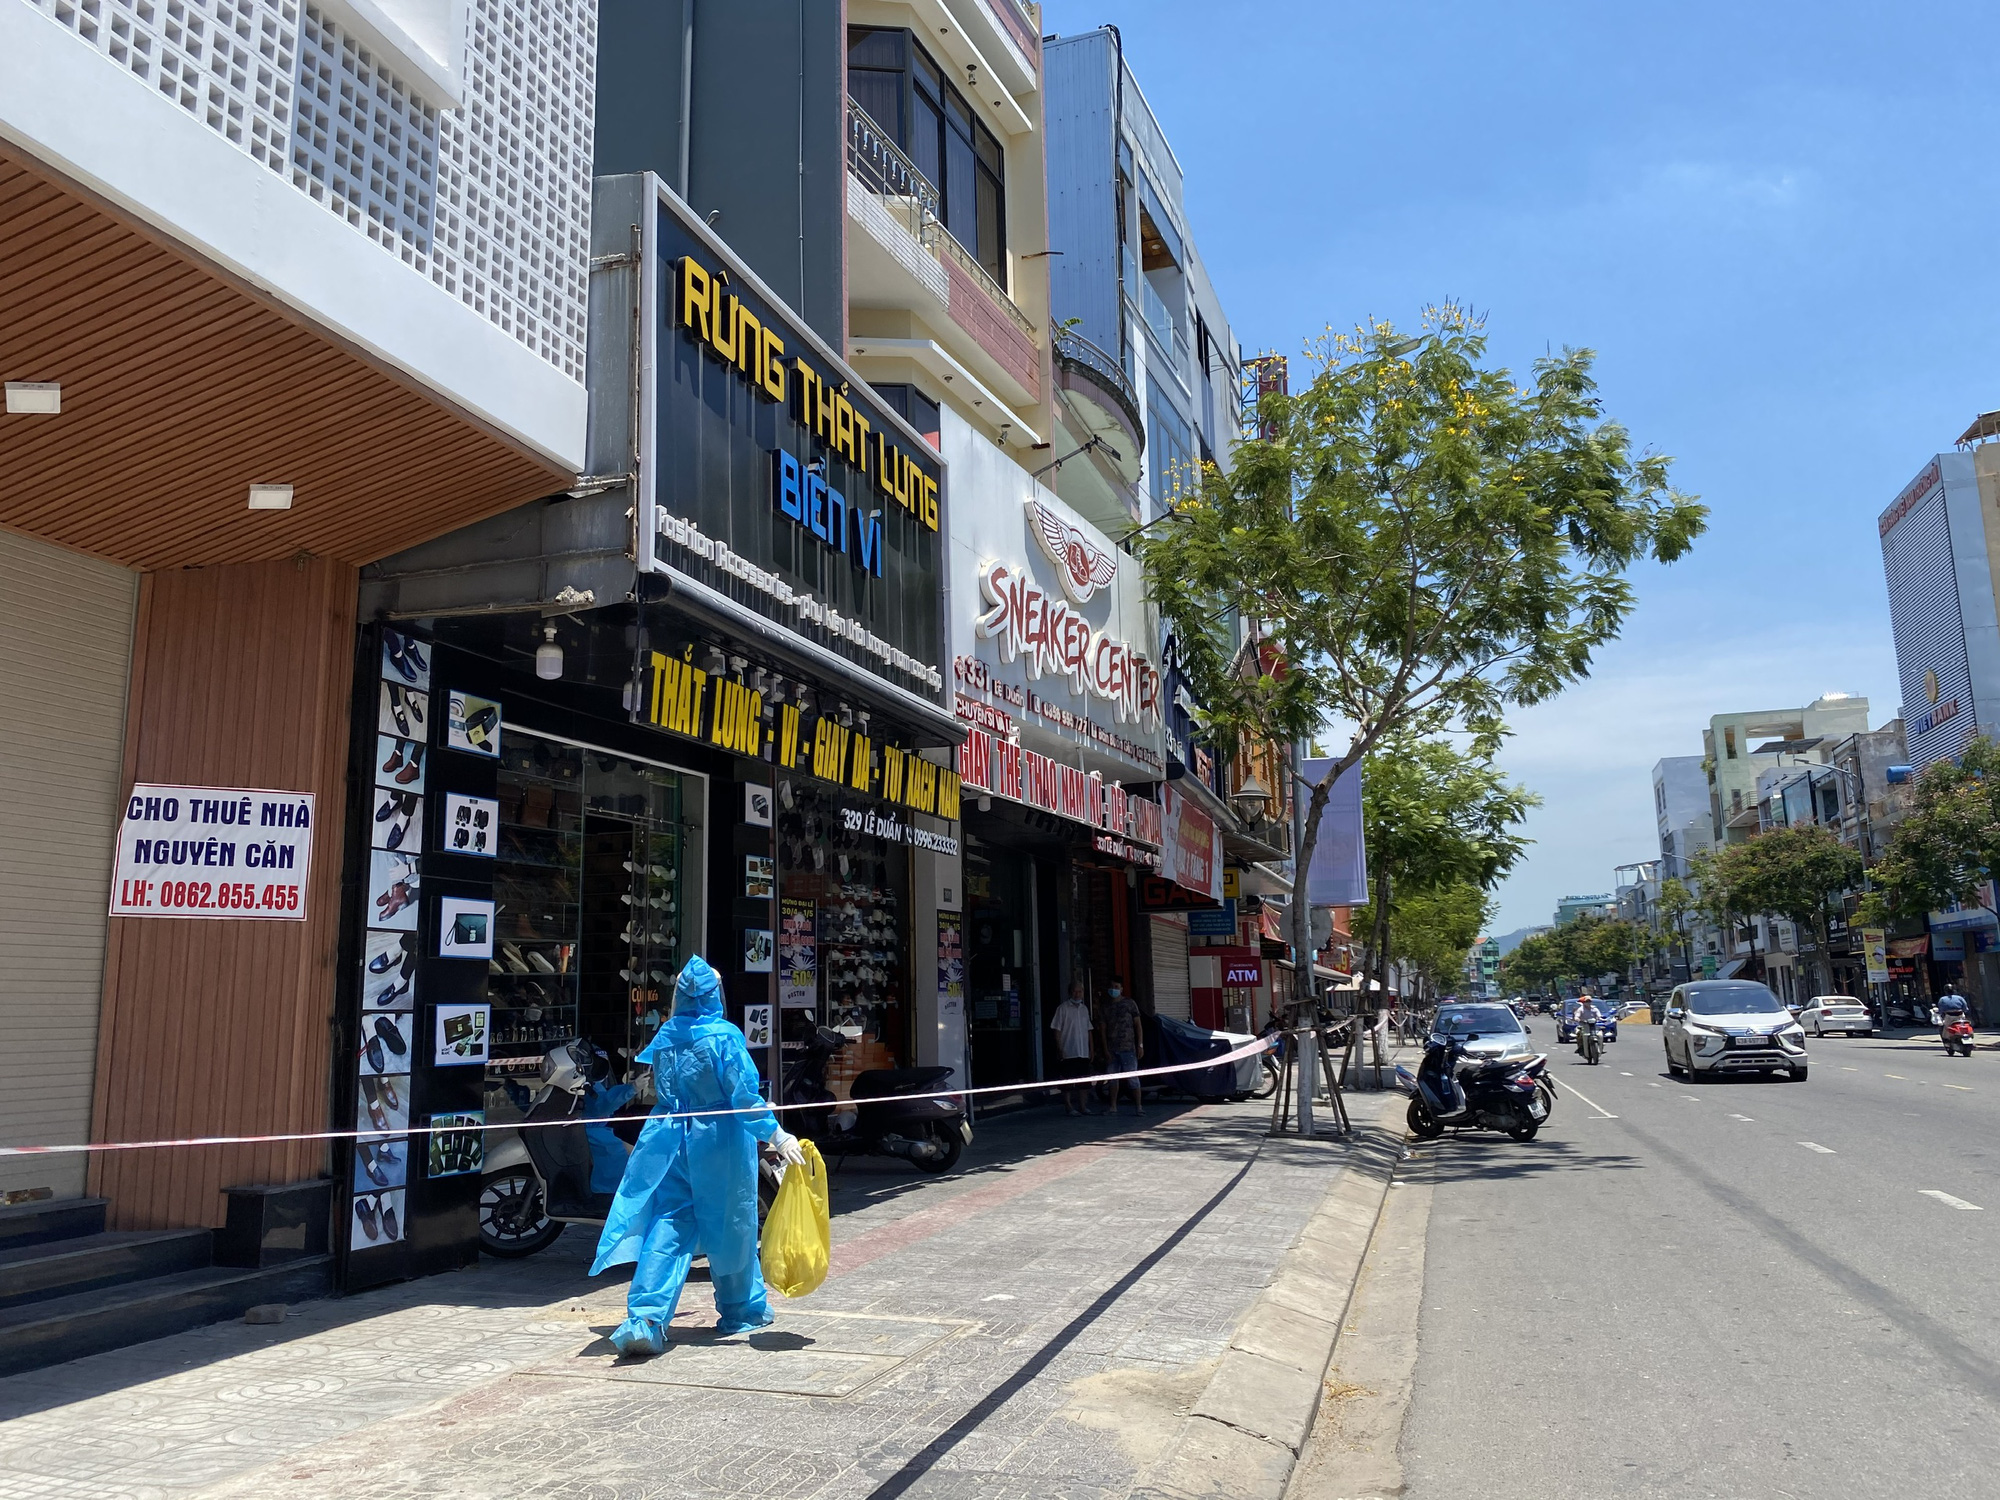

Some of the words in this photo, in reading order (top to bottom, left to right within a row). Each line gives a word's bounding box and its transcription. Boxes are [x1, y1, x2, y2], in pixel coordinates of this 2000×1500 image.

[656, 505, 714, 560] Fashion
[715, 540, 793, 605] Accessories
[986, 566, 1091, 687] SNEAKER
[1096, 638, 1161, 726] CENTER
[649, 644, 706, 737] THẮT
[711, 675, 762, 756] LƯNG
[851, 732, 871, 792] DA
[938, 766, 961, 821] NAM
[1915, 698, 1959, 735] VIETBANK
[1026, 750, 1057, 811] THAO
[1061, 765, 1086, 821] NAM
[127, 796, 179, 822] CHO
[189, 797, 252, 825] THUÊ
[260, 799, 310, 828] NHÀ
[844, 809, 862, 831] 329
[864, 809, 875, 834] LÊ
[134, 837, 236, 867] NGUYÊN
[245, 839, 296, 869] CĂN
[121, 879, 154, 907] LH:
[160, 881, 299, 911] 0862.855.455
[792, 970, 814, 986] 50%
[1226, 969, 1258, 982] ATM
